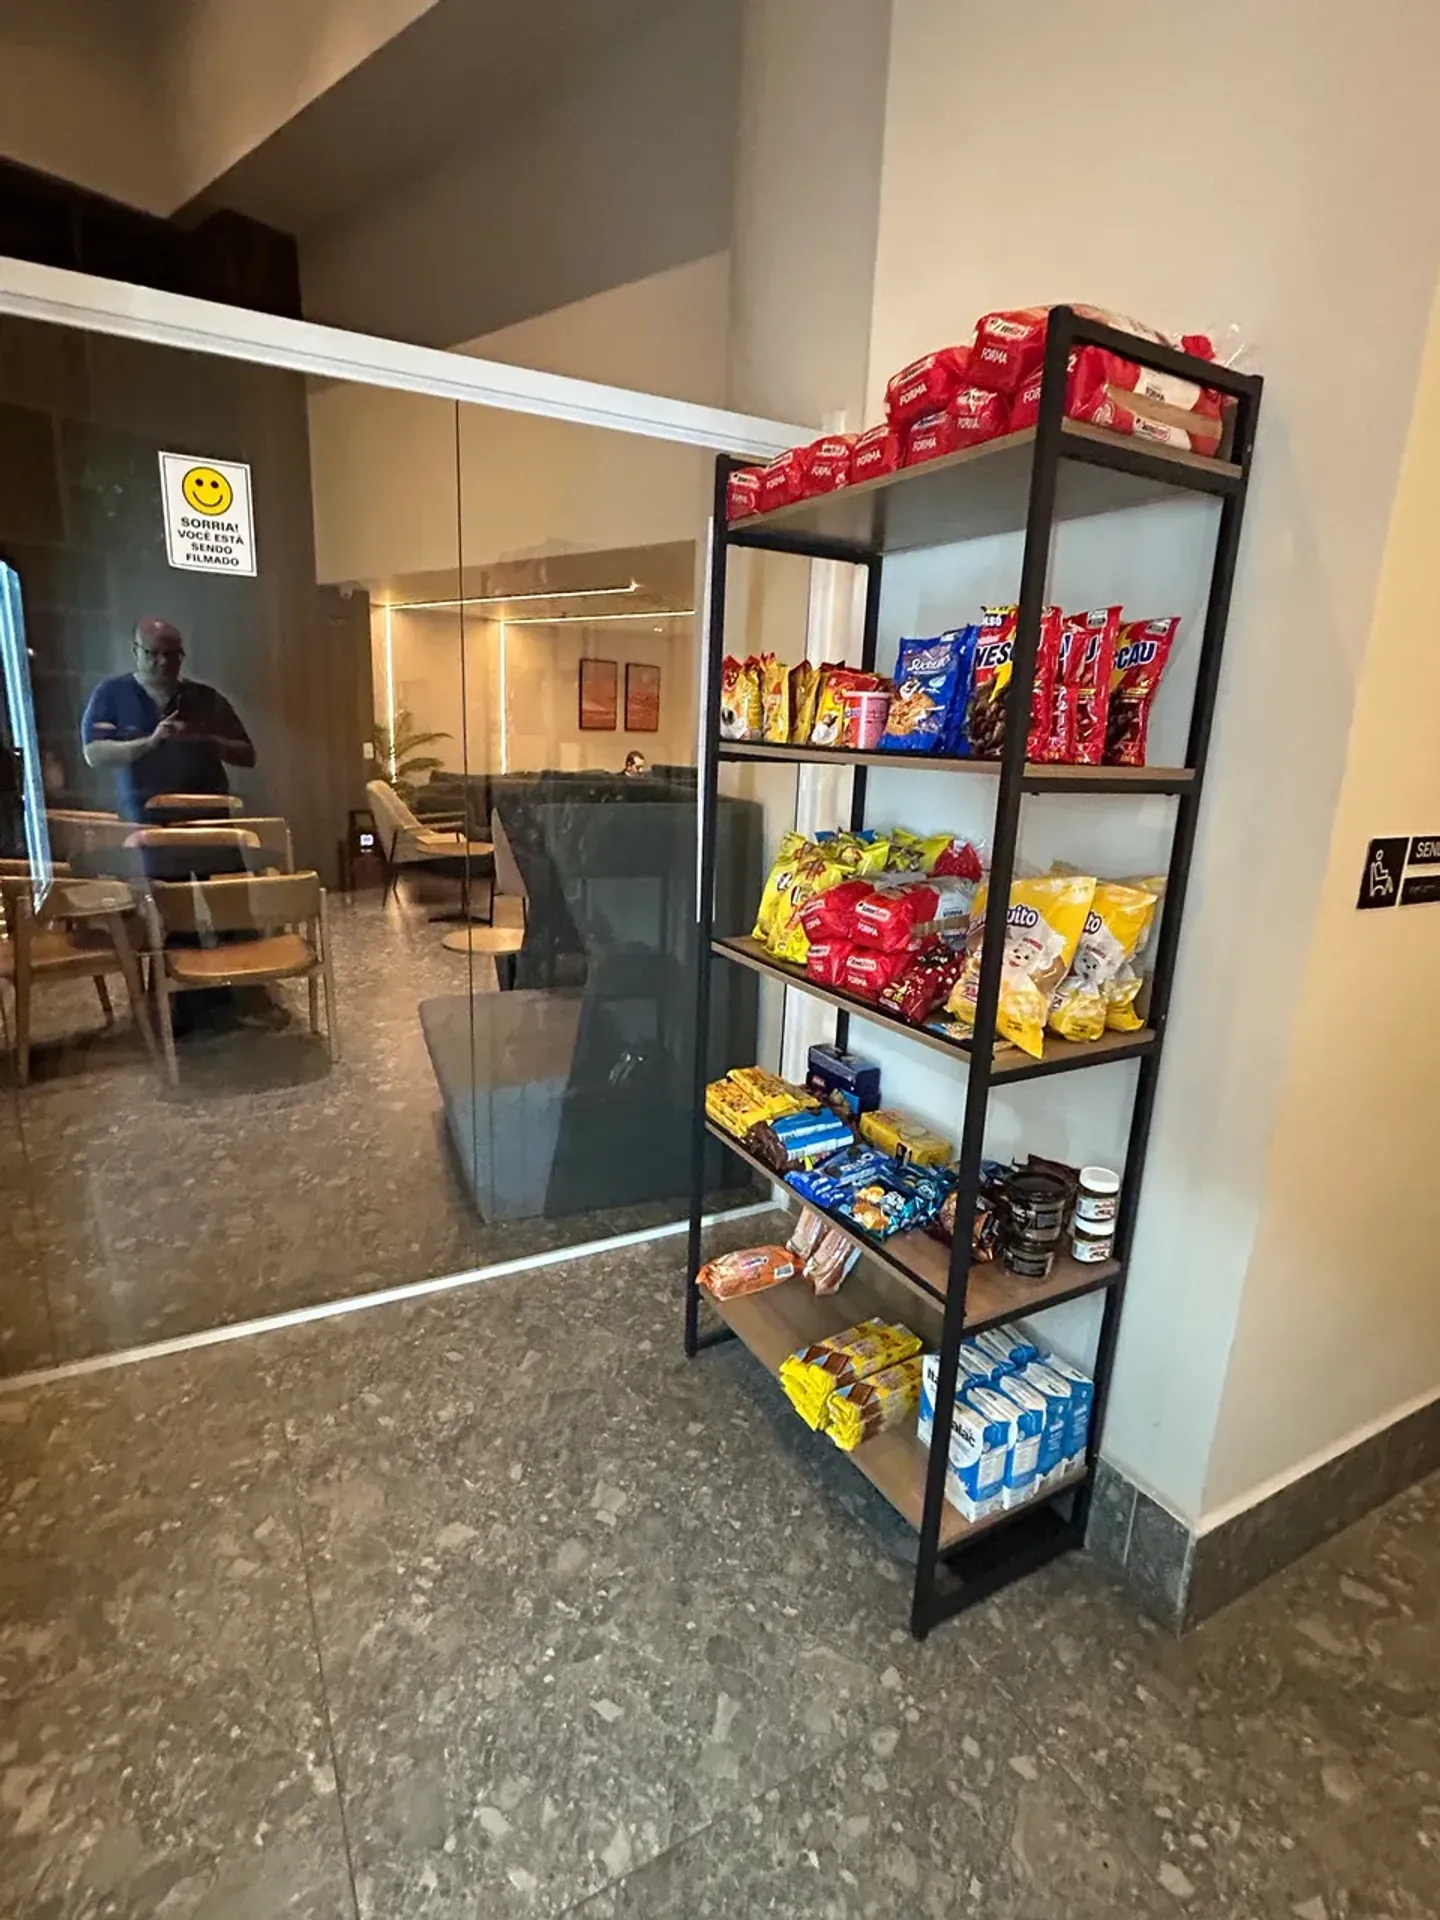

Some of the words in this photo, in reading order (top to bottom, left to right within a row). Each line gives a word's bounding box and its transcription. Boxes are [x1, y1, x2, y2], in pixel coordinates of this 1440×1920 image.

[981, 347, 1008, 365] FORMA
[899, 383, 927, 406] FORMA
[1023, 387, 1042, 404] FOR
[912, 437, 938, 452] FORMA
[856, 449, 882, 467] FORMA
[181, 517, 238, 532] SORRIA!
[178, 529, 211, 541] VOCÊ
[191, 542, 232, 554] SENDO
[186, 553, 239, 566] FILMADO
[975, 642, 1014, 667] NES
[1115, 641, 1156, 669] CAU
